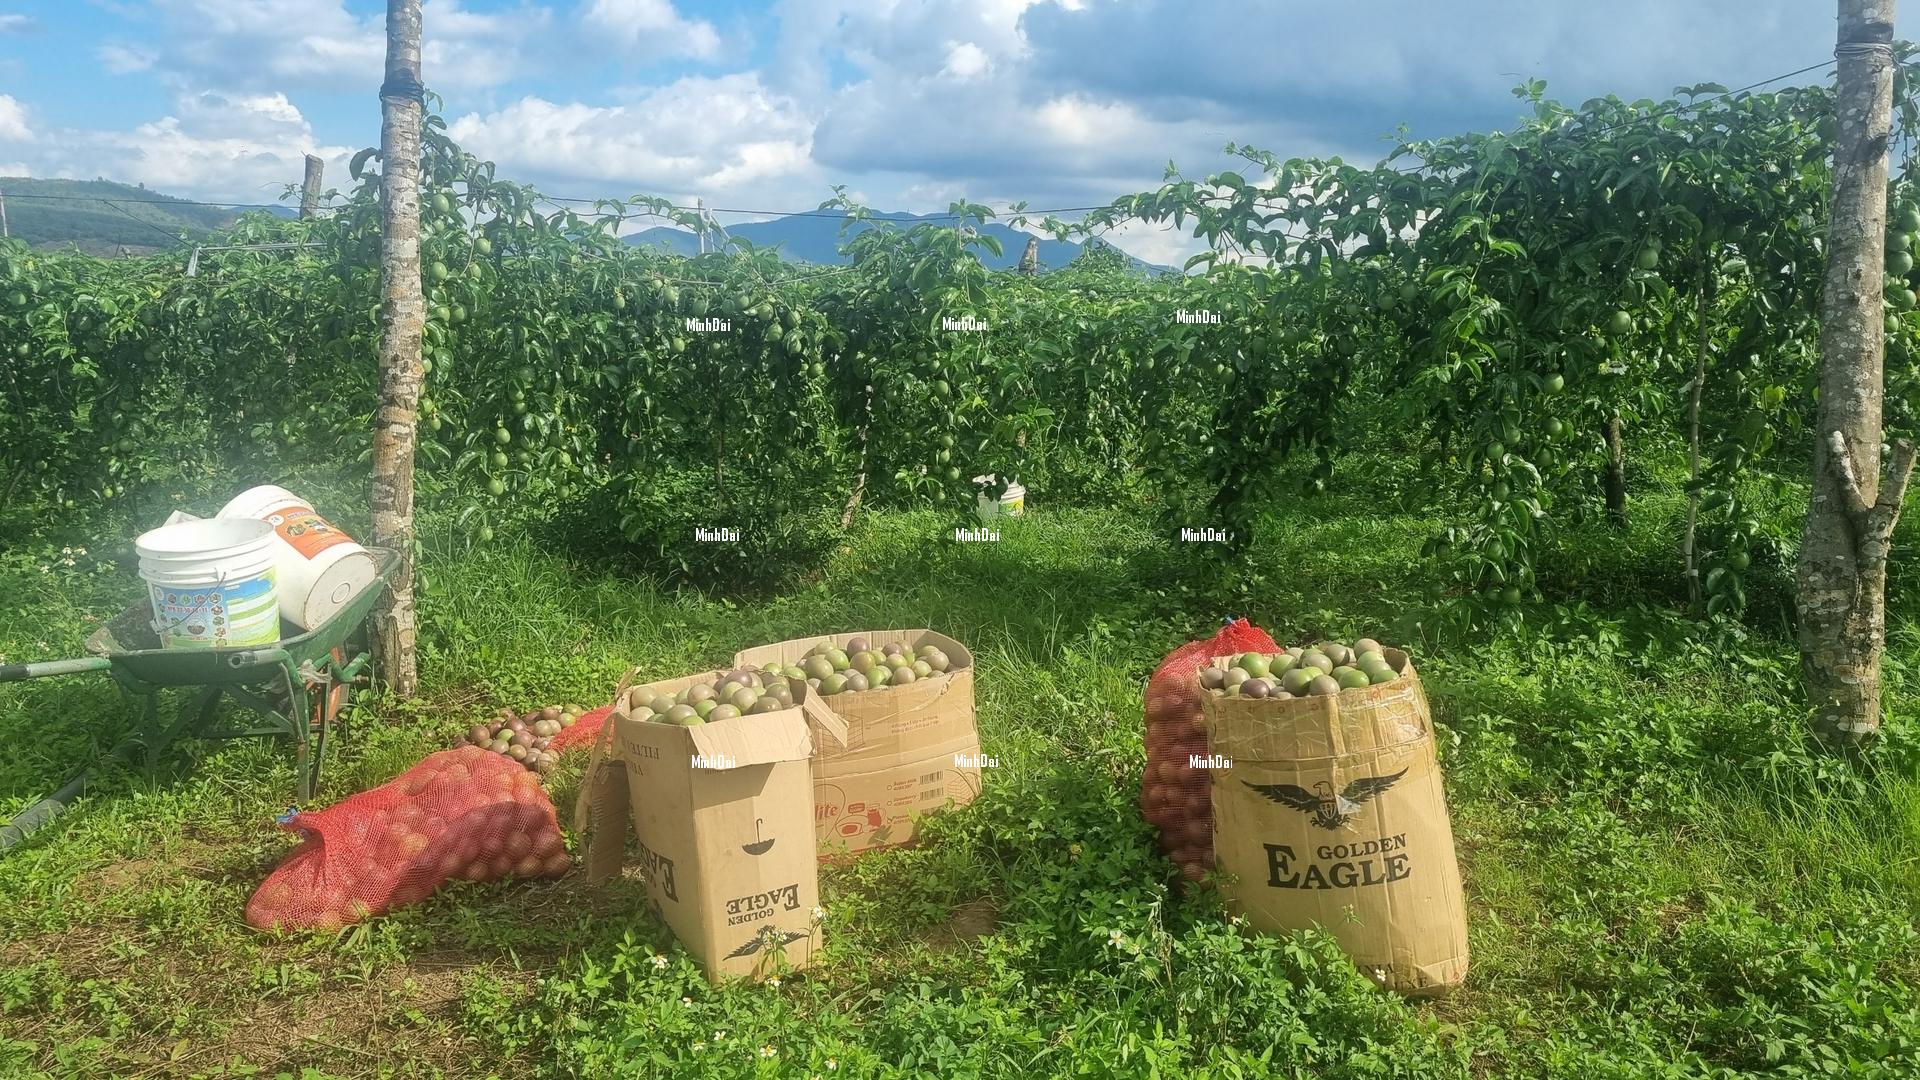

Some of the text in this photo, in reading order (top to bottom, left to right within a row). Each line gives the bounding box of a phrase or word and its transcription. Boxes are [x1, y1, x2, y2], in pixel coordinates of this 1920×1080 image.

[1317, 833, 1406, 860] GOLDEN
[1263, 843, 1412, 889] EAGLE
[726, 884, 800, 915] EAGLE
[728, 908, 774, 926] GOLDEN
